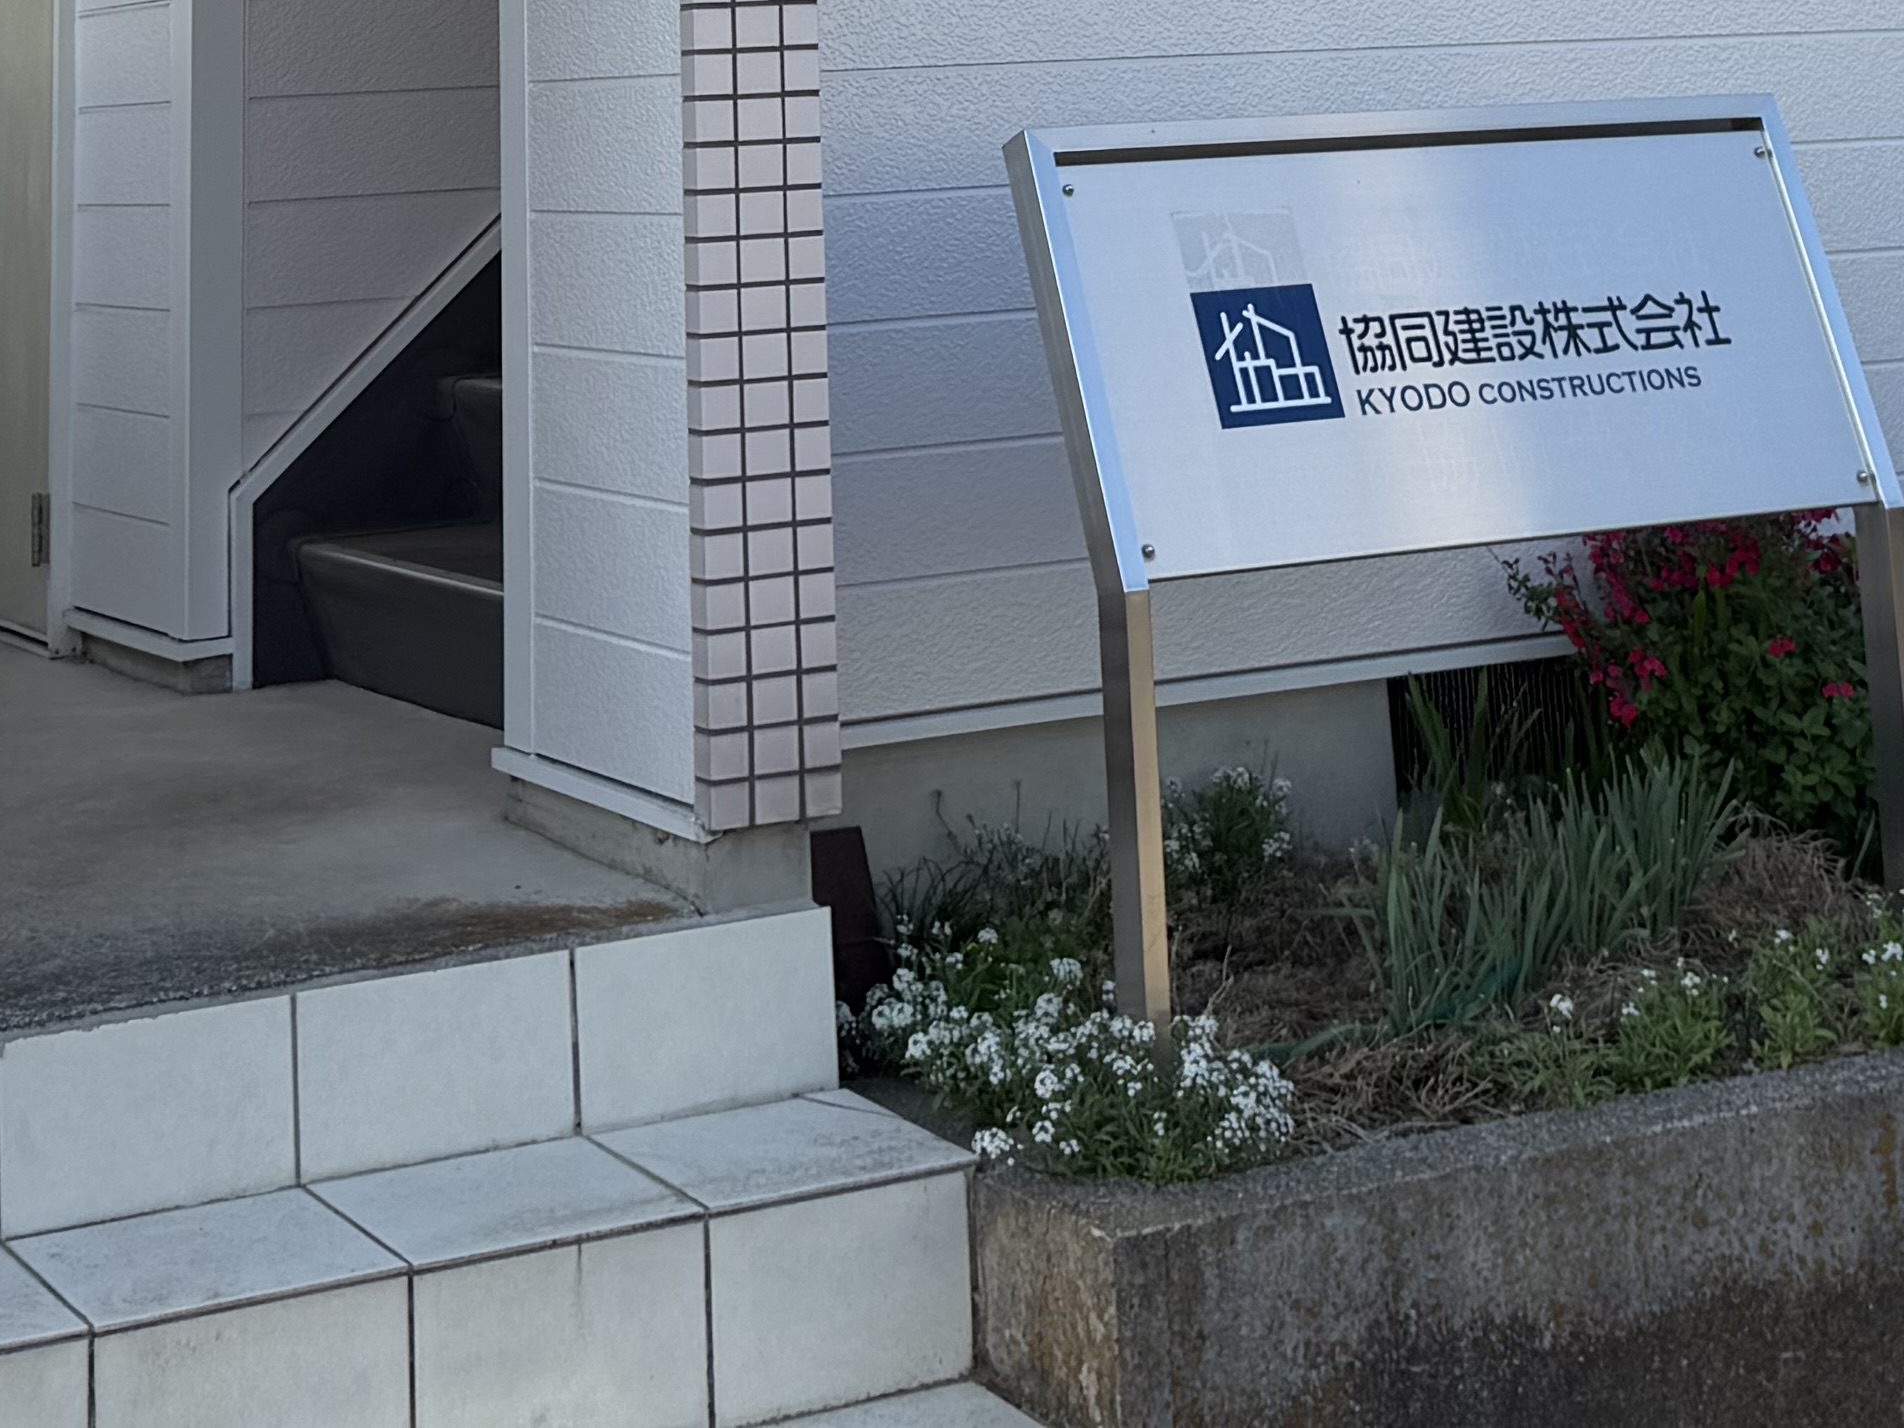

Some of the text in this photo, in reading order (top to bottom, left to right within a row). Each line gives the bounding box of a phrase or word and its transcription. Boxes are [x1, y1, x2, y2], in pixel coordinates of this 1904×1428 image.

[1339, 290, 1732, 375] 協同建設株式会社
[1356, 366, 1702, 415] KYODO CONSTRUCTIONS
